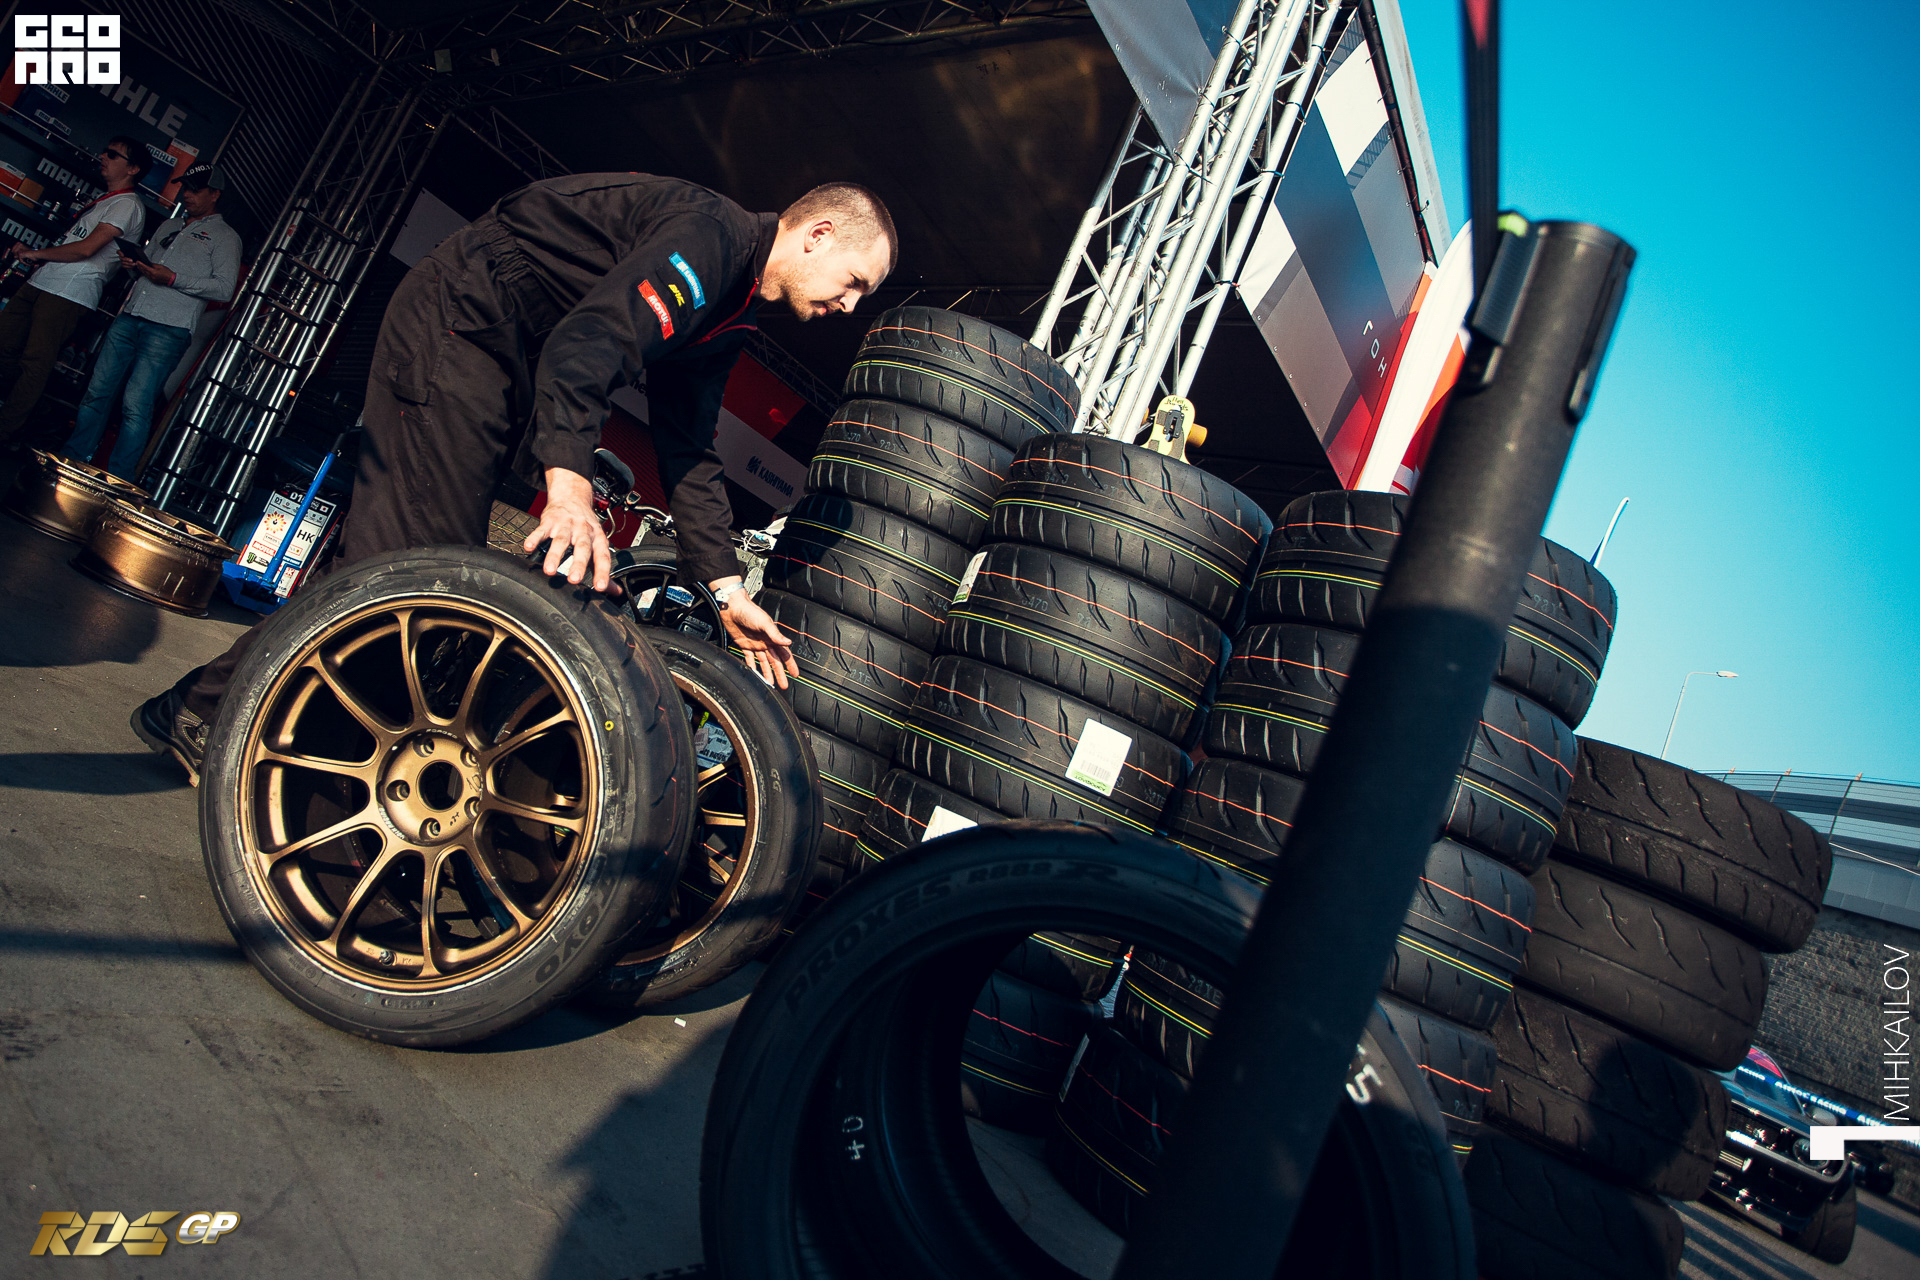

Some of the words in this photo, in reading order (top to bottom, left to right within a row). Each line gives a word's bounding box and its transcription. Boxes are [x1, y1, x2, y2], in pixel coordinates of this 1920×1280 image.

[98, 74, 188, 138] HLE
[1, 218, 51, 250] MAH
[648, 294, 669, 327] MOTUL
[759, 462, 794, 498] KASHIYAMA
[253, 541, 275, 557] MOTUL
[784, 879, 952, 1011] PROXES
[1737, 1065, 1767, 1081] ACING
